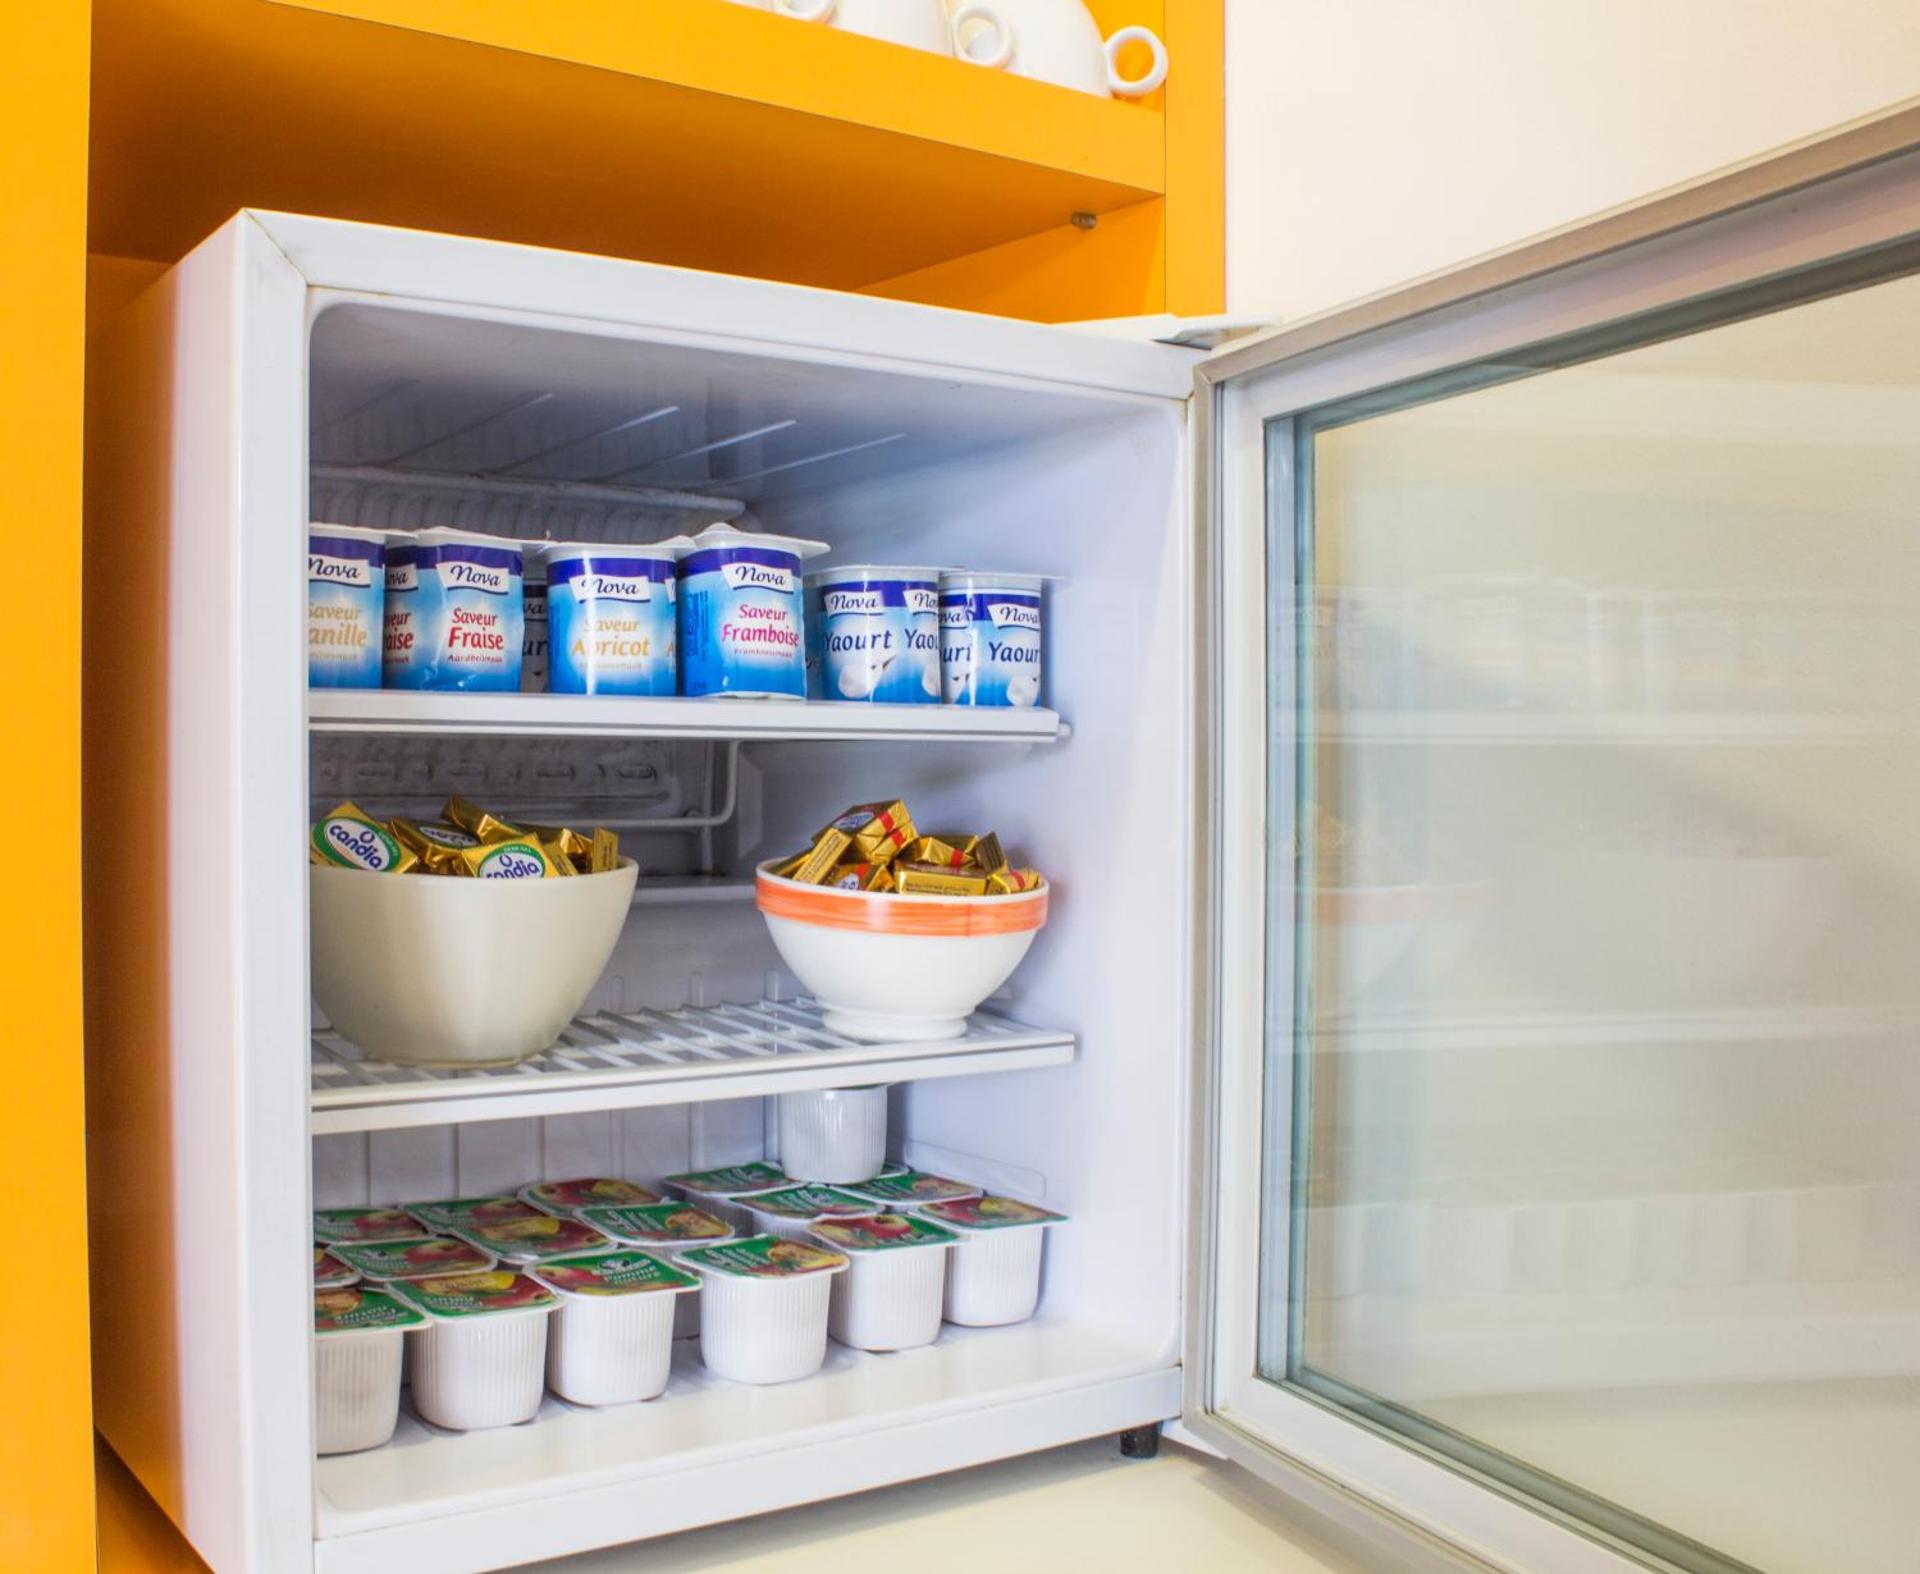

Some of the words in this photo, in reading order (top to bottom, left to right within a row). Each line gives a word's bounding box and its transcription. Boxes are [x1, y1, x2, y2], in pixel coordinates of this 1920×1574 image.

[450, 565, 501, 586] Nova
[735, 566, 785, 586] Nova
[830, 594, 878, 610] Nova
[914, 592, 937, 607] No
[452, 607, 498, 626] Saveur
[739, 603, 787, 621] Saveur
[309, 622, 367, 648] anille
[385, 627, 414, 651] aise
[447, 626, 504, 650] Fraise
[721, 623, 800, 648] Framboise
[824, 629, 893, 652] Yaourt
[904, 628, 938, 649] Yao
[329, 825, 382, 868] candia
